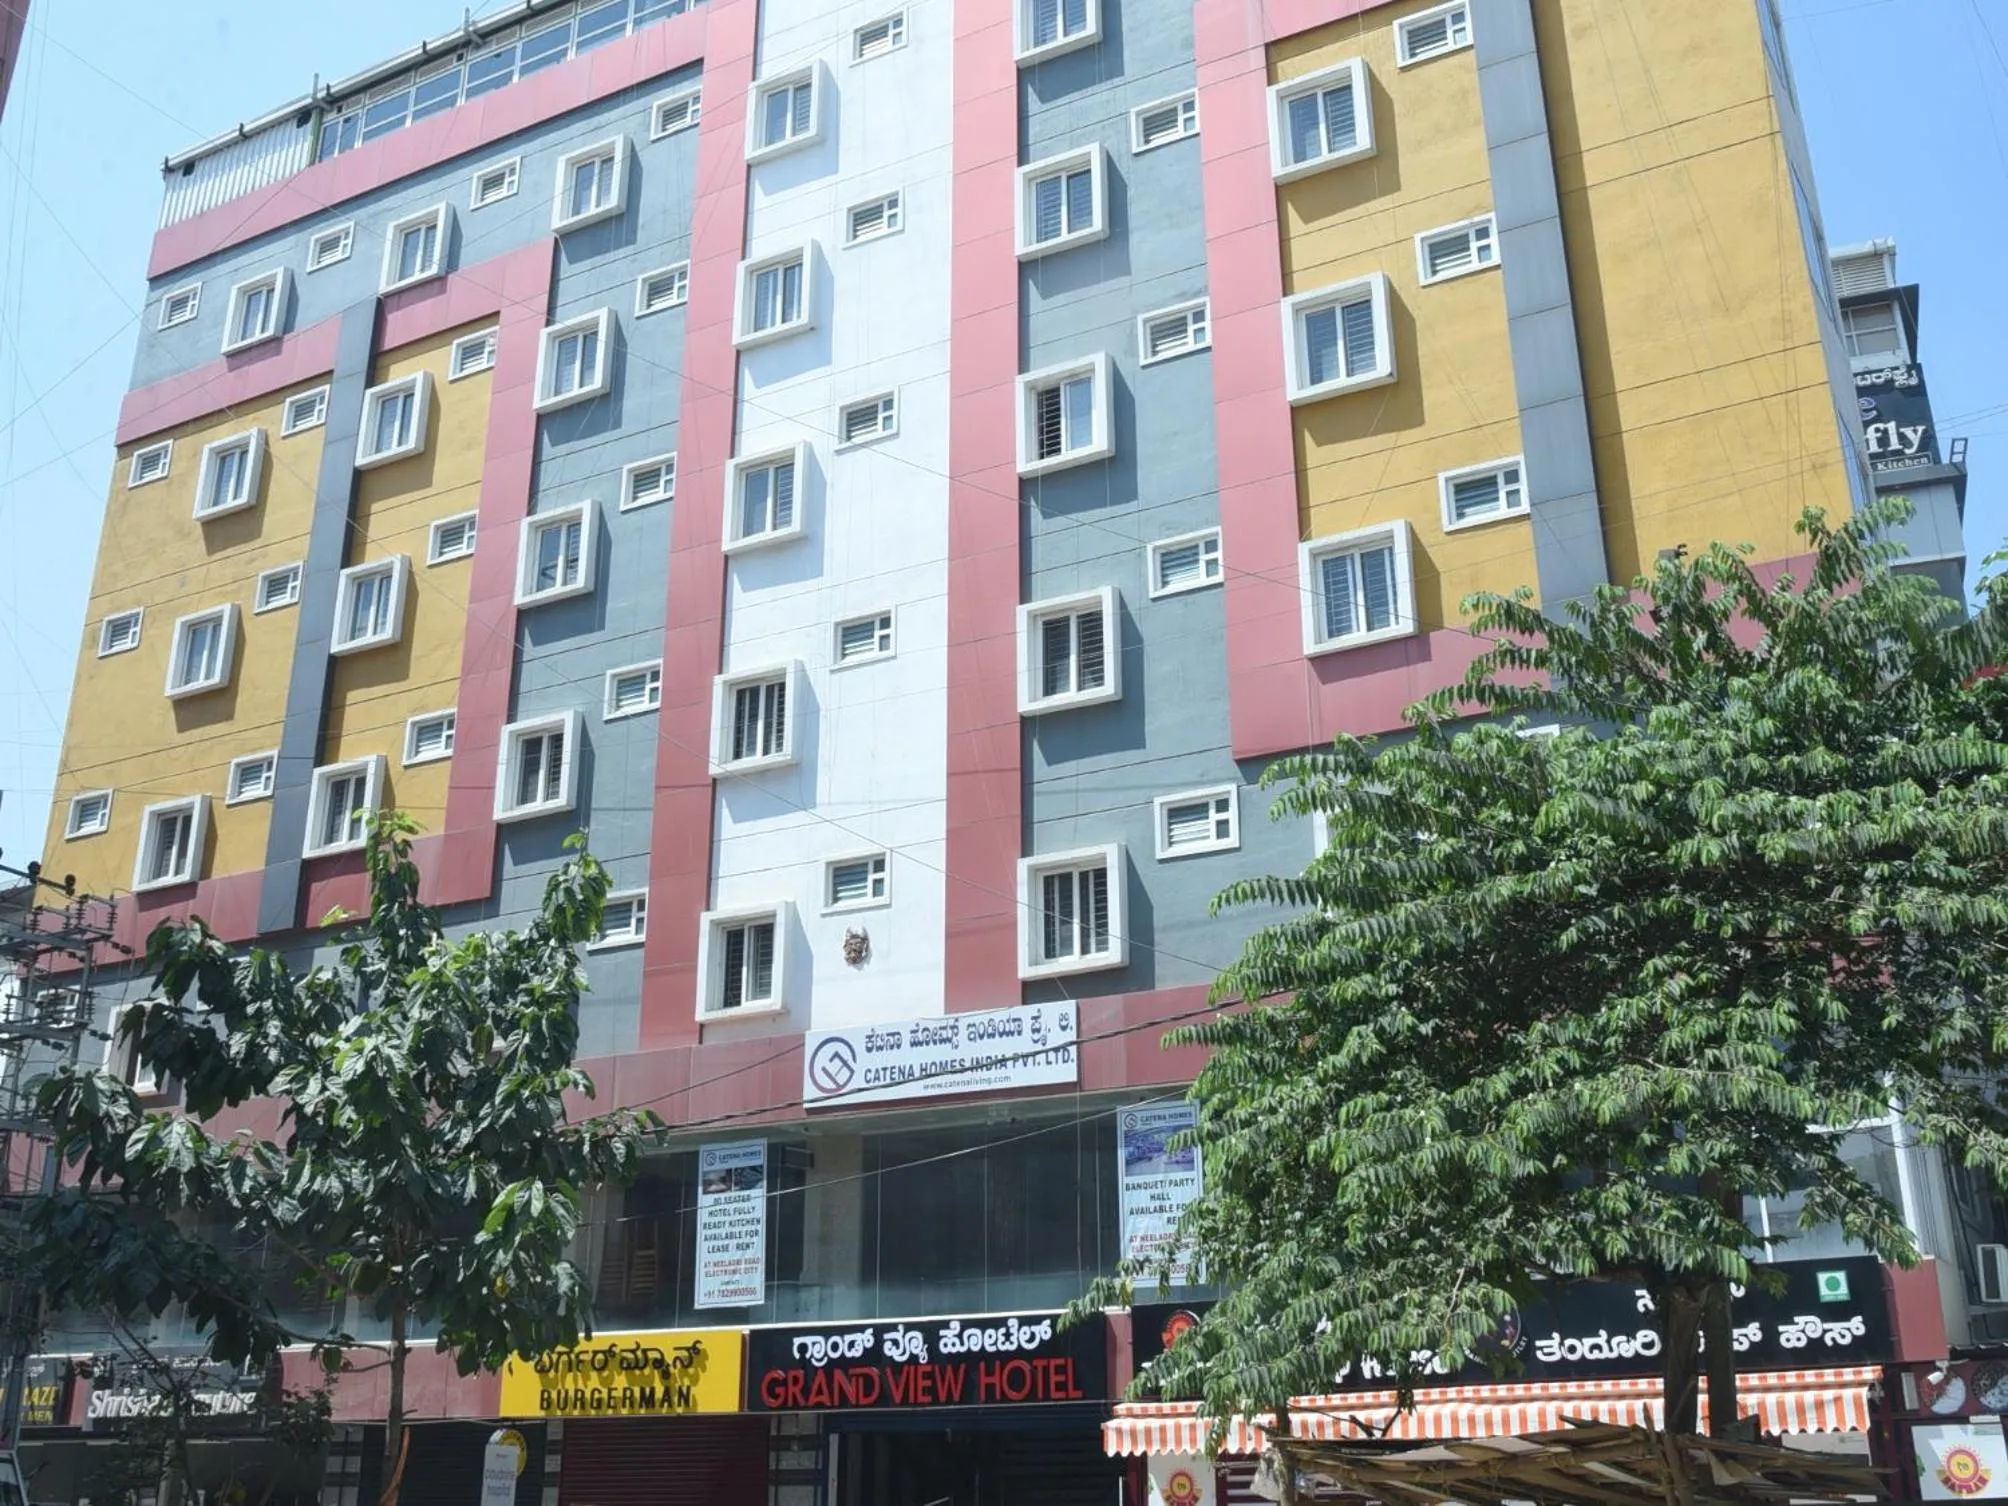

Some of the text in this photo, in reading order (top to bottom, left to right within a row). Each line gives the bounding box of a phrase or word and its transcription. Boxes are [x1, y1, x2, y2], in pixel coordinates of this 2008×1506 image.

[1876, 457, 1929, 470] Kitchen
[966, 1015, 1023, 1042] ಇಂಡಿಯಾ
[864, 1046, 1075, 1084] CATENA HOMES INDIA PVT. LTD.
[923, 1075, 1012, 1089] www.catenaliving.com
[1168, 1177, 1195, 1188] PARTY
[1150, 1192, 1172, 1201] HALL
[708, 1206, 756, 1218] HOTEL FULLY
[1129, 1202, 1190, 1216] AVAILABLE FO
[702, 1217, 760, 1230] READY KITCHEN
[703, 1228, 760, 1242] AVAILABLE FOR
[707, 1243, 730, 1253] LEASE
[736, 1241, 755, 1250] RENT
[793, 1317, 1052, 1367] ಗ್ರಾಂಡ್ ವ್ಯೂ ಹೋಟೆಲ್
[1535, 1328, 1662, 1362] ತಂದೂರಿ
[1777, 1315, 1866, 1349] ಹೌಸ್
[761, 1356, 1085, 1408] GRAND VIEW HOTEL
[540, 1385, 692, 1411] BURGERMAN
